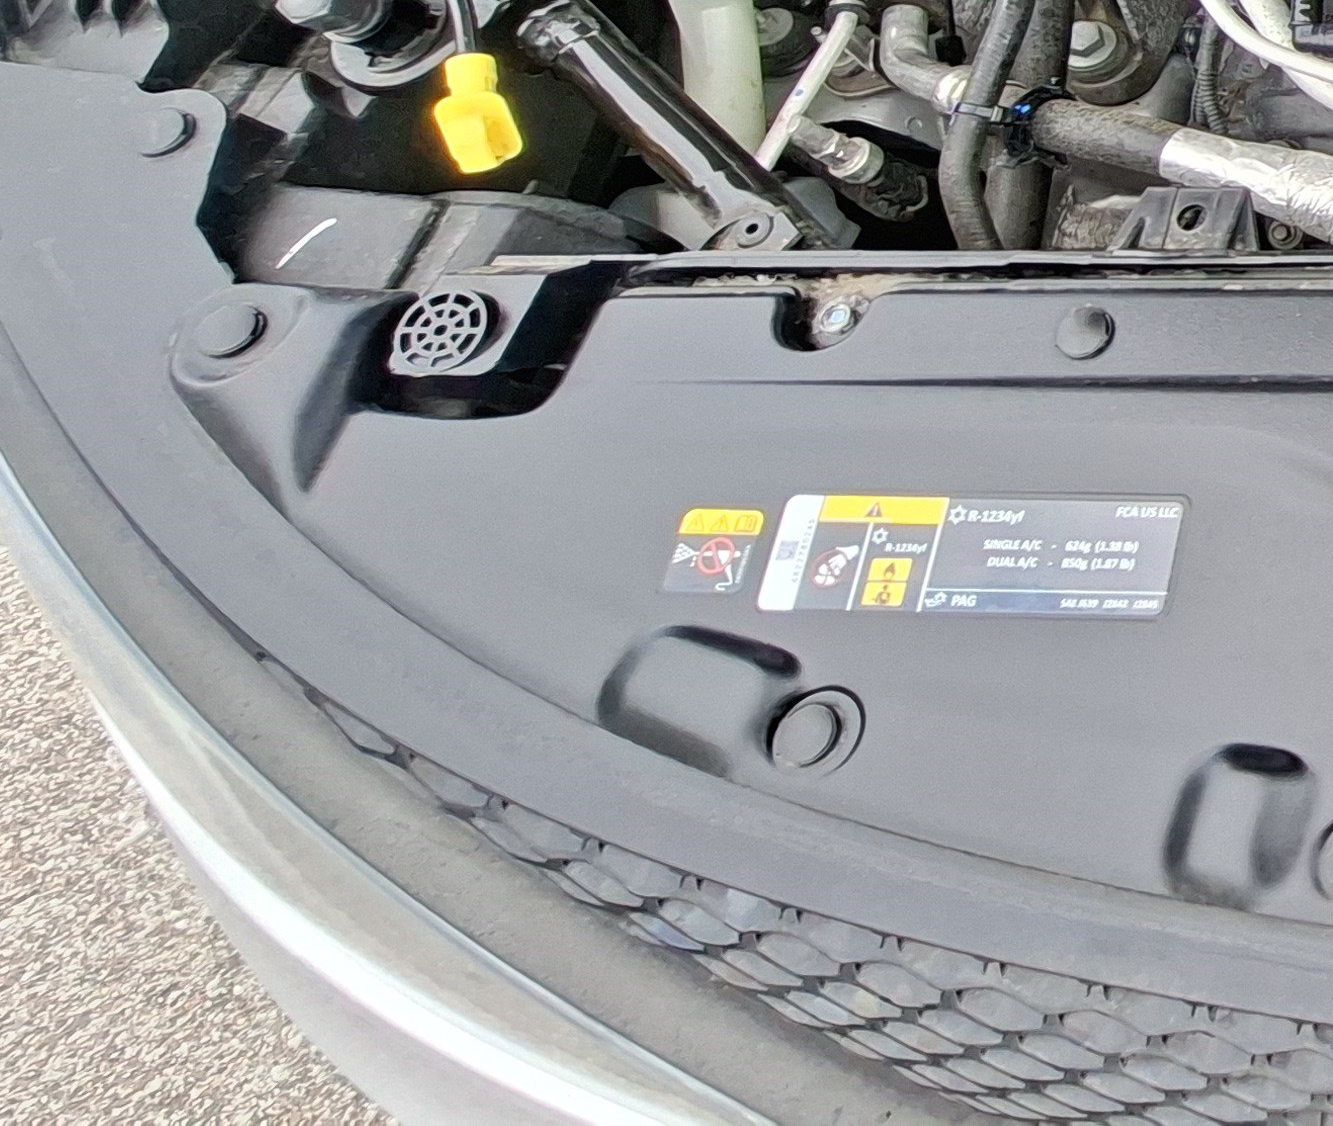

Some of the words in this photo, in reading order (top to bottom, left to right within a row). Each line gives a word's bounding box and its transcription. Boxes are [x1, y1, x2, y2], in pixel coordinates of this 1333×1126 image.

[967, 510, 1025, 525] R-1234yf
[1116, 506, 1139, 518] FCA
[1140, 507, 1156, 518] US
[1157, 507, 1179, 518] LLC
[983, 539, 1020, 551] SINGLE
[1020, 539, 1042, 551] A/C
[986, 556, 1016, 568] DUAL
[1017, 556, 1038, 570] A/C
[951, 595, 977, 607] PAG
